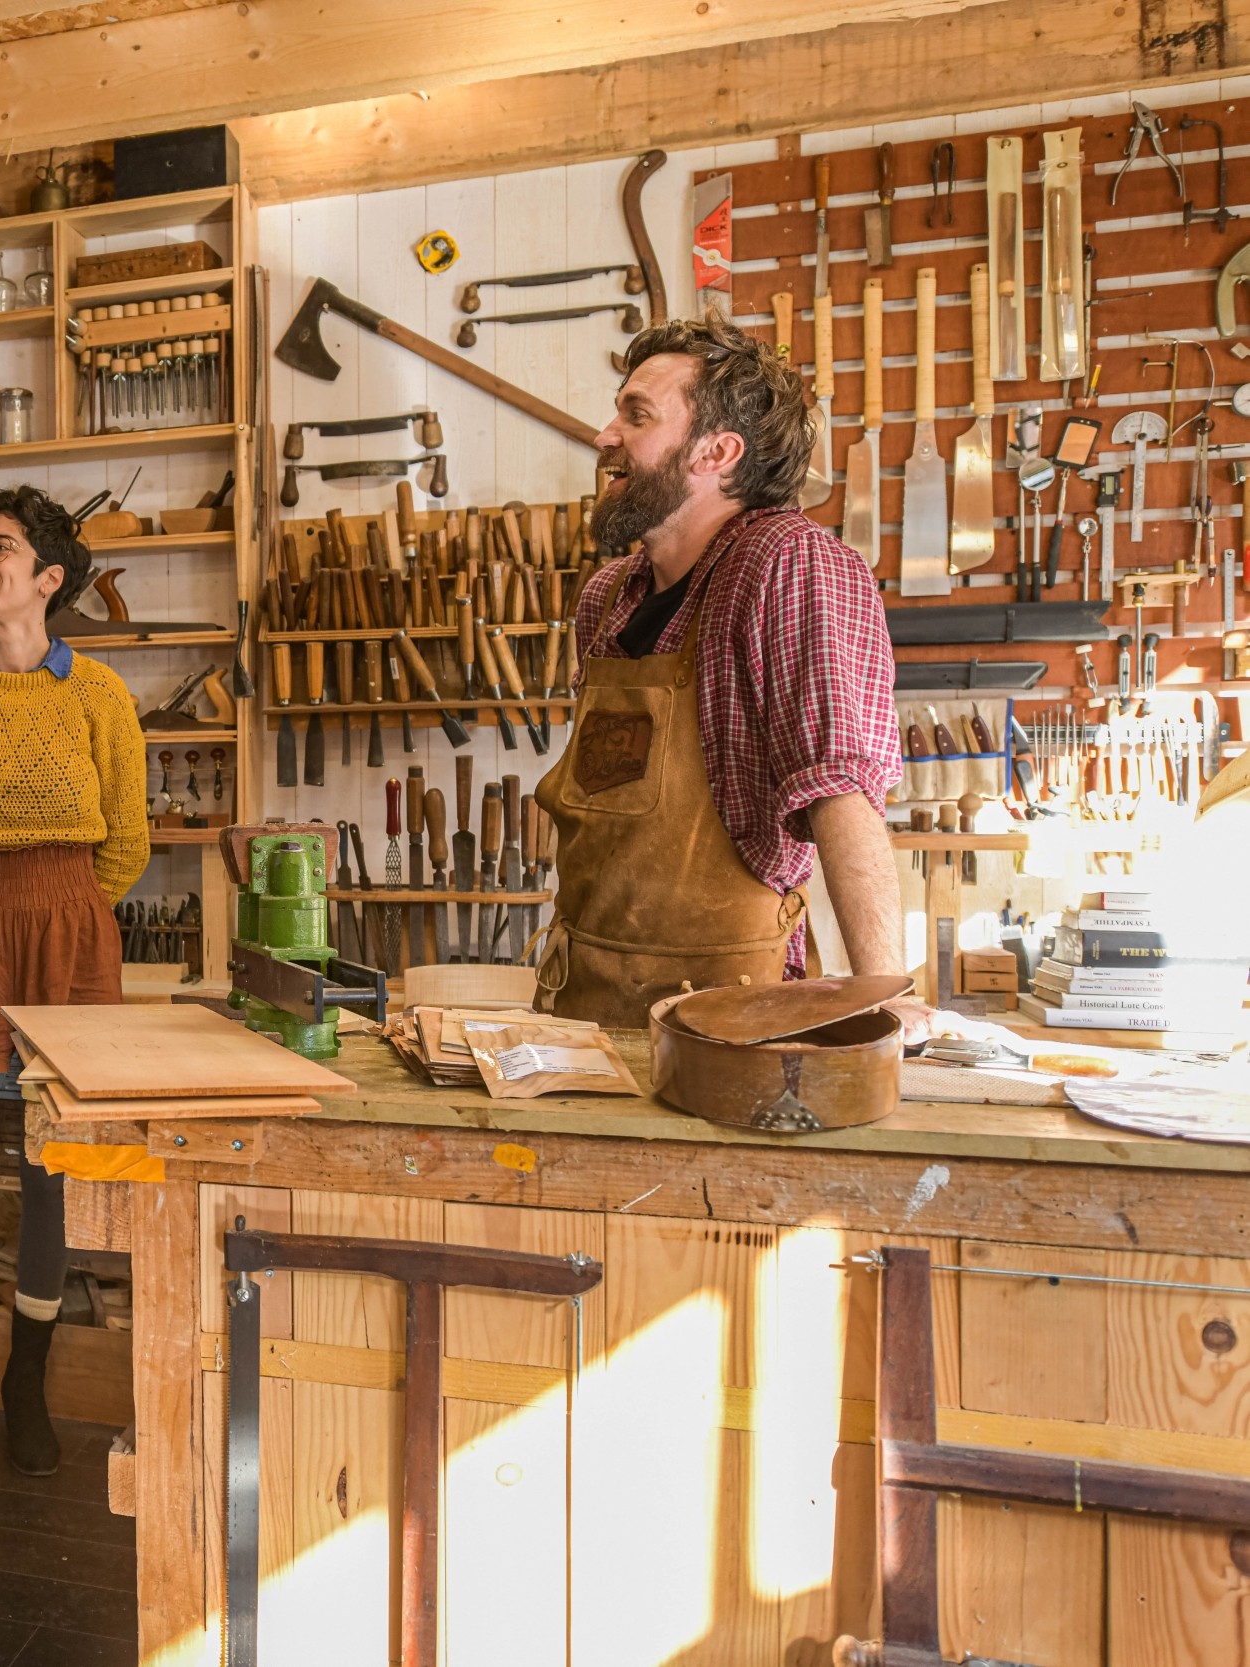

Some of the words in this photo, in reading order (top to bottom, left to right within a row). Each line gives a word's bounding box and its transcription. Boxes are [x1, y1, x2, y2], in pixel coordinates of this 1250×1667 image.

[700, 225, 726, 233] DICK
[1093, 919, 1144, 927] SYMPATHIE
[1119, 947, 1150, 957] THE
[1152, 948, 1168, 957] W
[1079, 999, 1118, 1009] Historical
[1121, 1001, 1140, 1010] Lute
[1127, 1017, 1161, 1027] TRAITÉ
